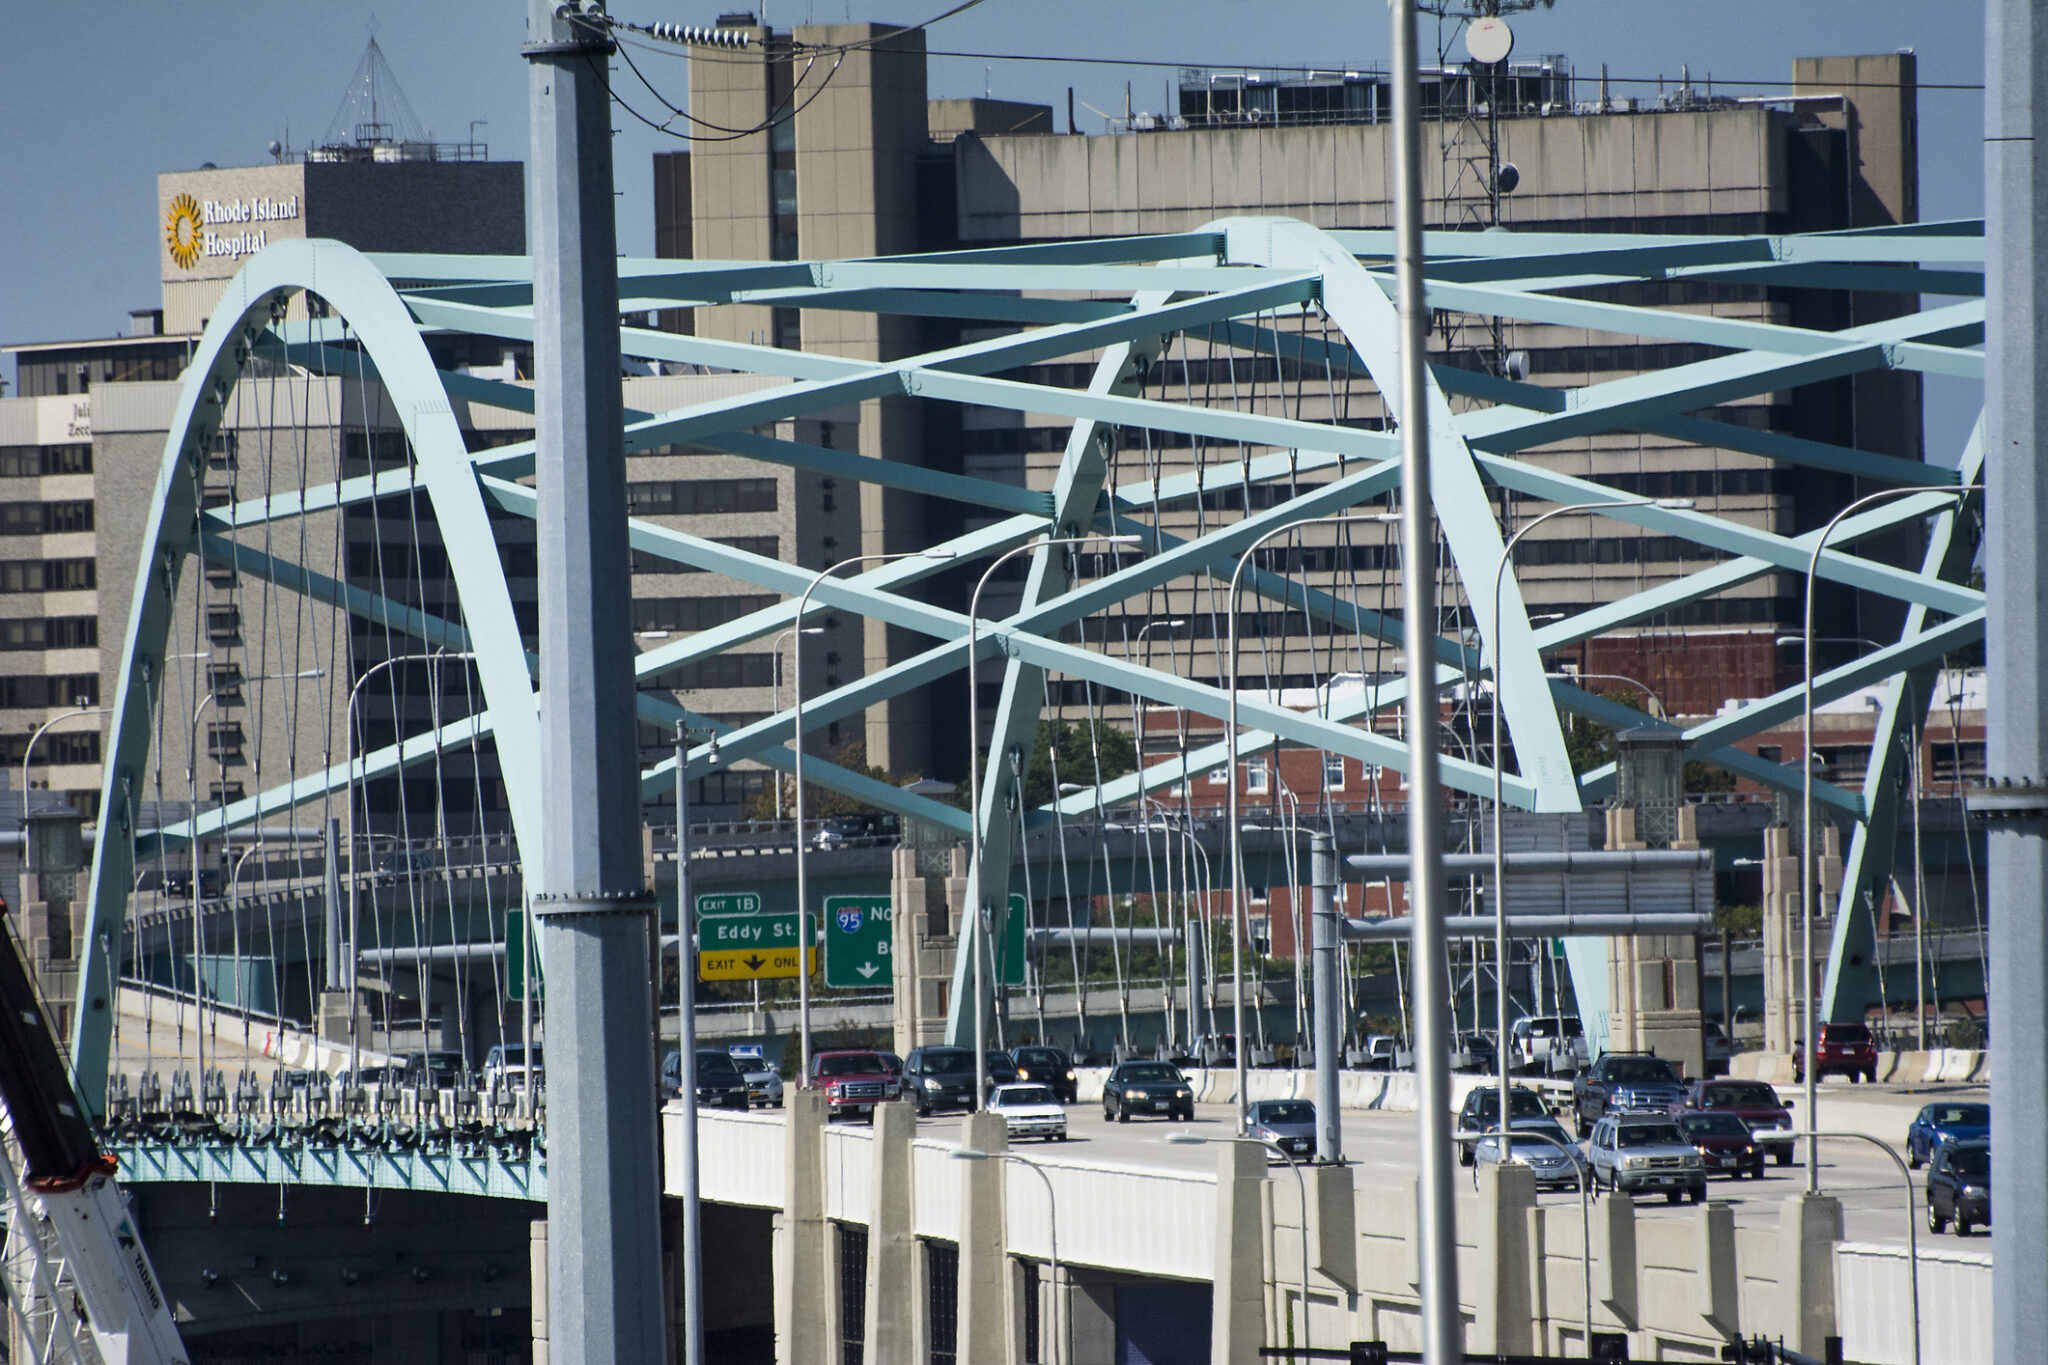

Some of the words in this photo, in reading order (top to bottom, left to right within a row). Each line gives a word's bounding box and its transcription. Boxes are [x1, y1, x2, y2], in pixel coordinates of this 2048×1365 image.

[204, 199, 251, 224] Rhode
[252, 195, 298, 220] Island
[205, 230, 266, 261] Hospital
[703, 900, 726, 911] EXIT
[736, 898, 754, 911] 1B
[839, 913, 860, 929] 95
[718, 924, 762, 941] Eddy
[773, 922, 796, 938] St.
[877, 941, 892, 955] B
[707, 959, 735, 970] EXIT
[773, 957, 799, 968] ONL
[135, 1253, 160, 1310] TADANO
